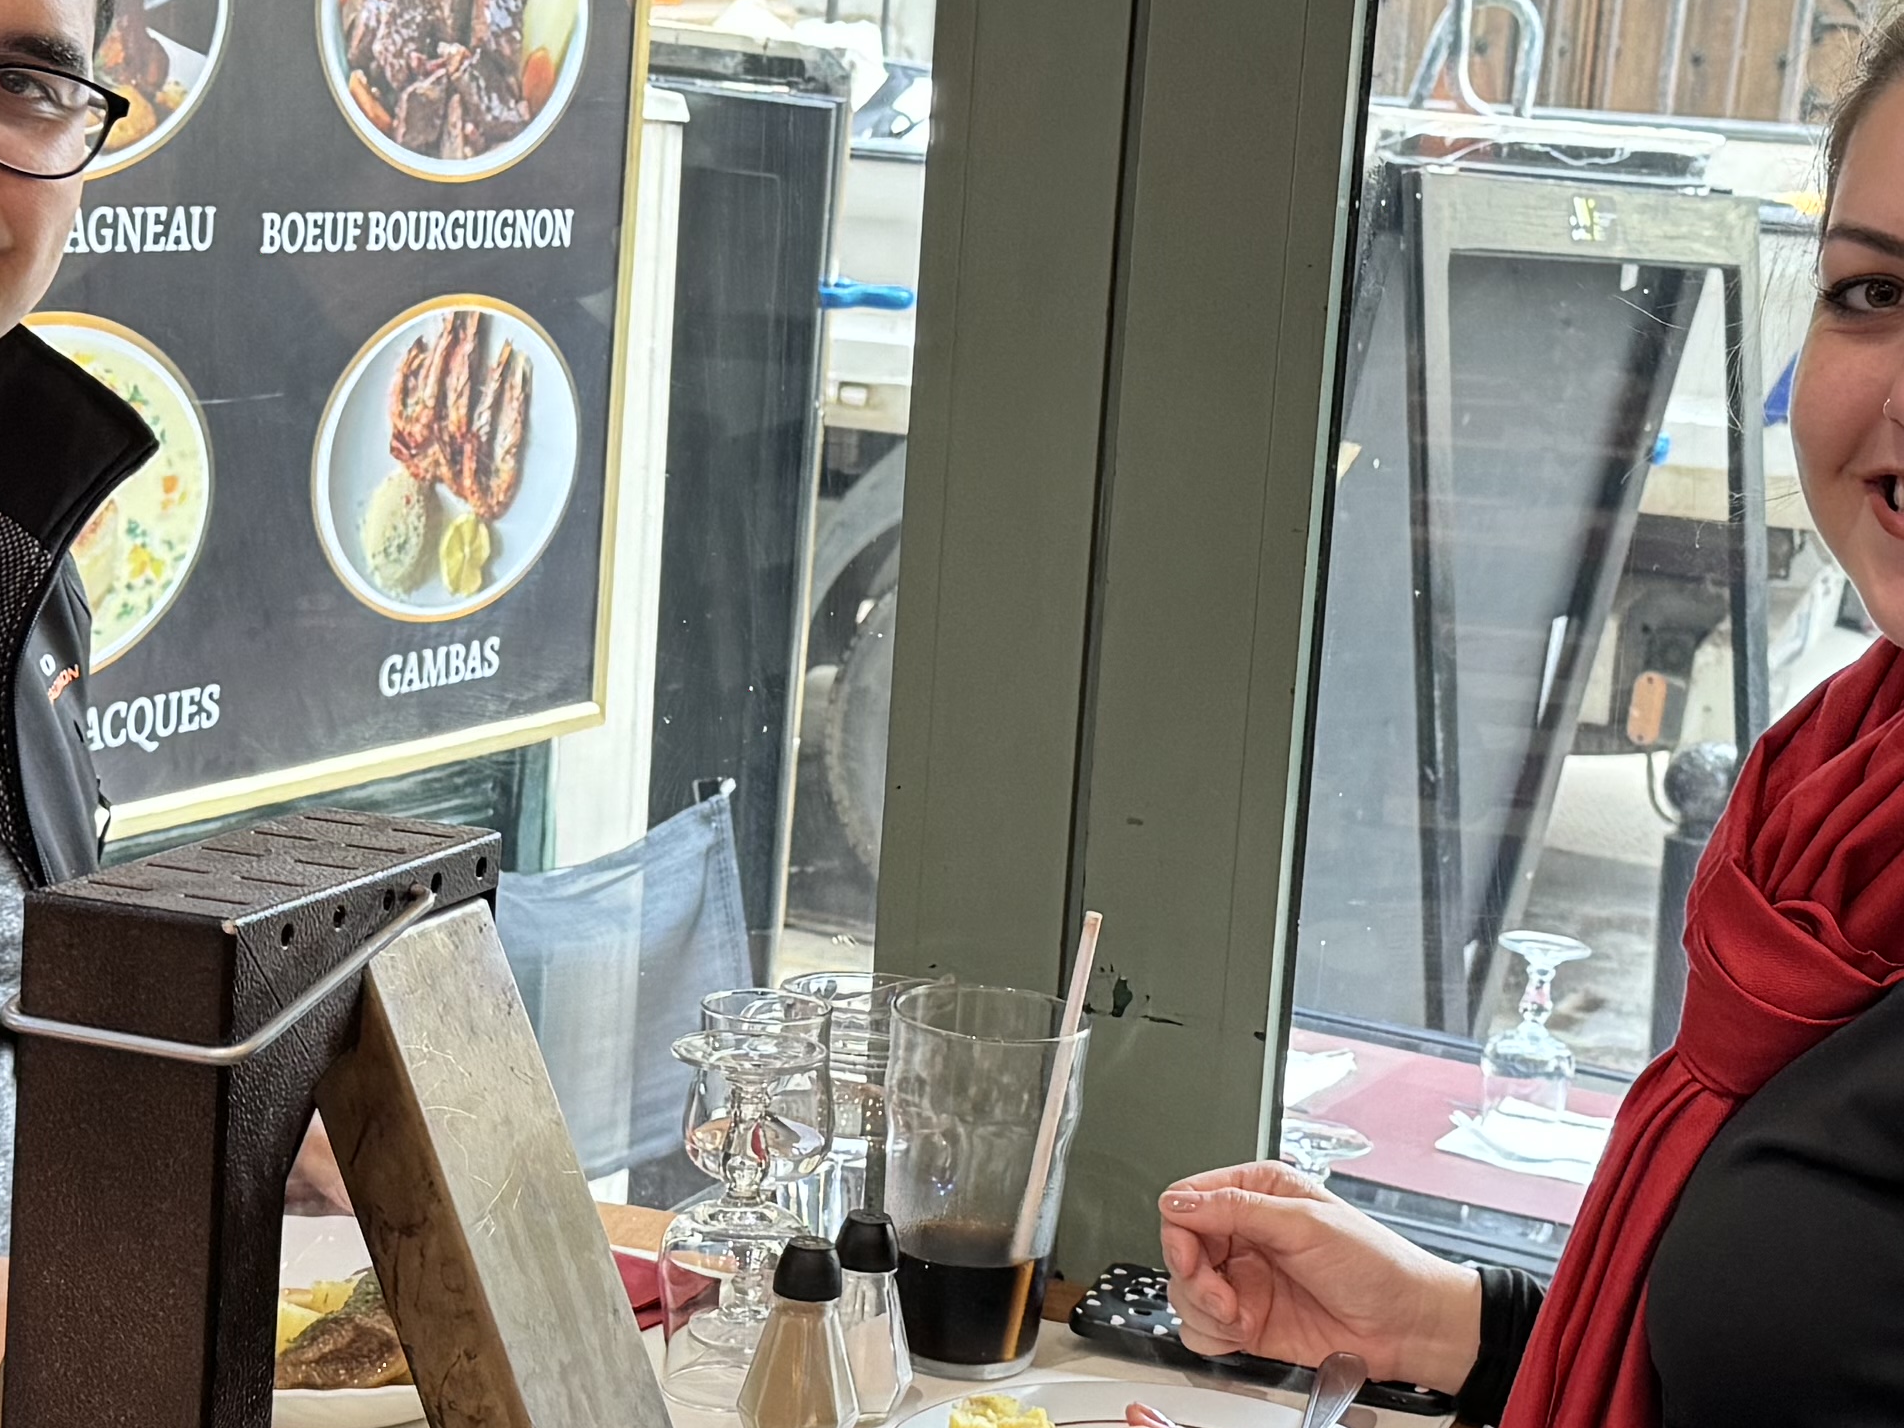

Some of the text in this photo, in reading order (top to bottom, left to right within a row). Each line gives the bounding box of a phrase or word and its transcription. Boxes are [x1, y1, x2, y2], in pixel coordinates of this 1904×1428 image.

[259, 207, 575, 254] BOEUF BOURGUIGNON
[378, 636, 501, 697] GAMBAS
